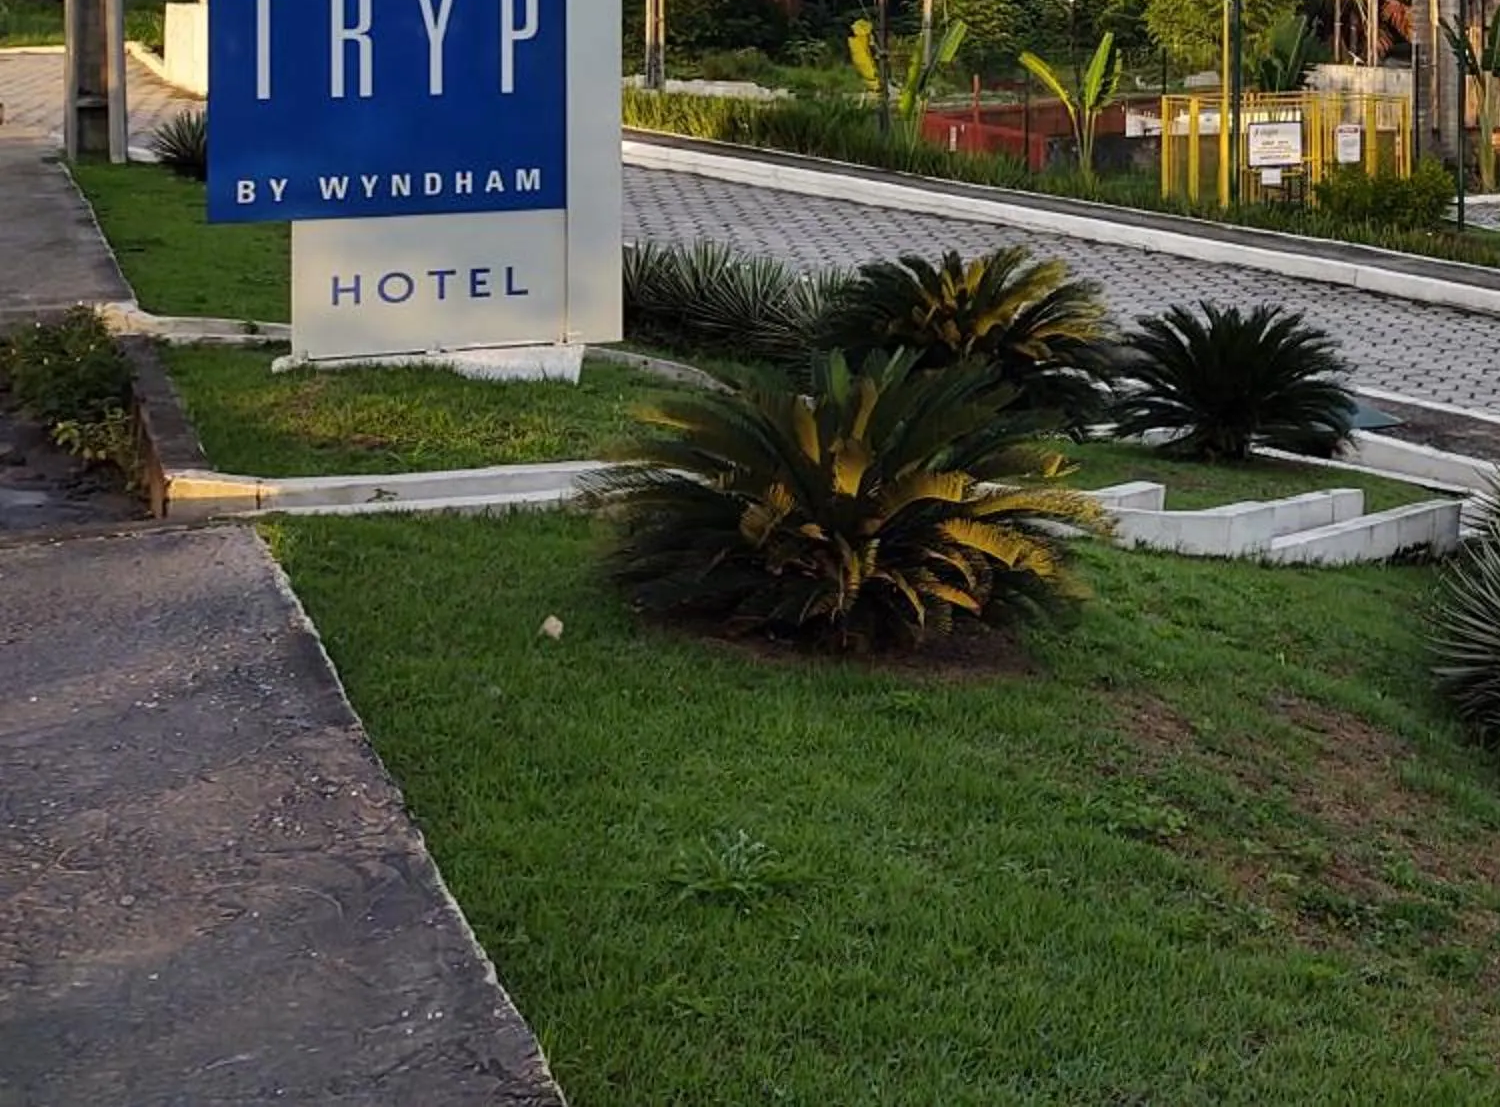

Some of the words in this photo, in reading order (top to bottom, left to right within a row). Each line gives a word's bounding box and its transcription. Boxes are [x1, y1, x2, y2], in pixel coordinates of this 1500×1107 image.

[236, 179, 289, 204] BY
[319, 168, 541, 201] WYNDHAM
[331, 266, 530, 306] HOTEL
